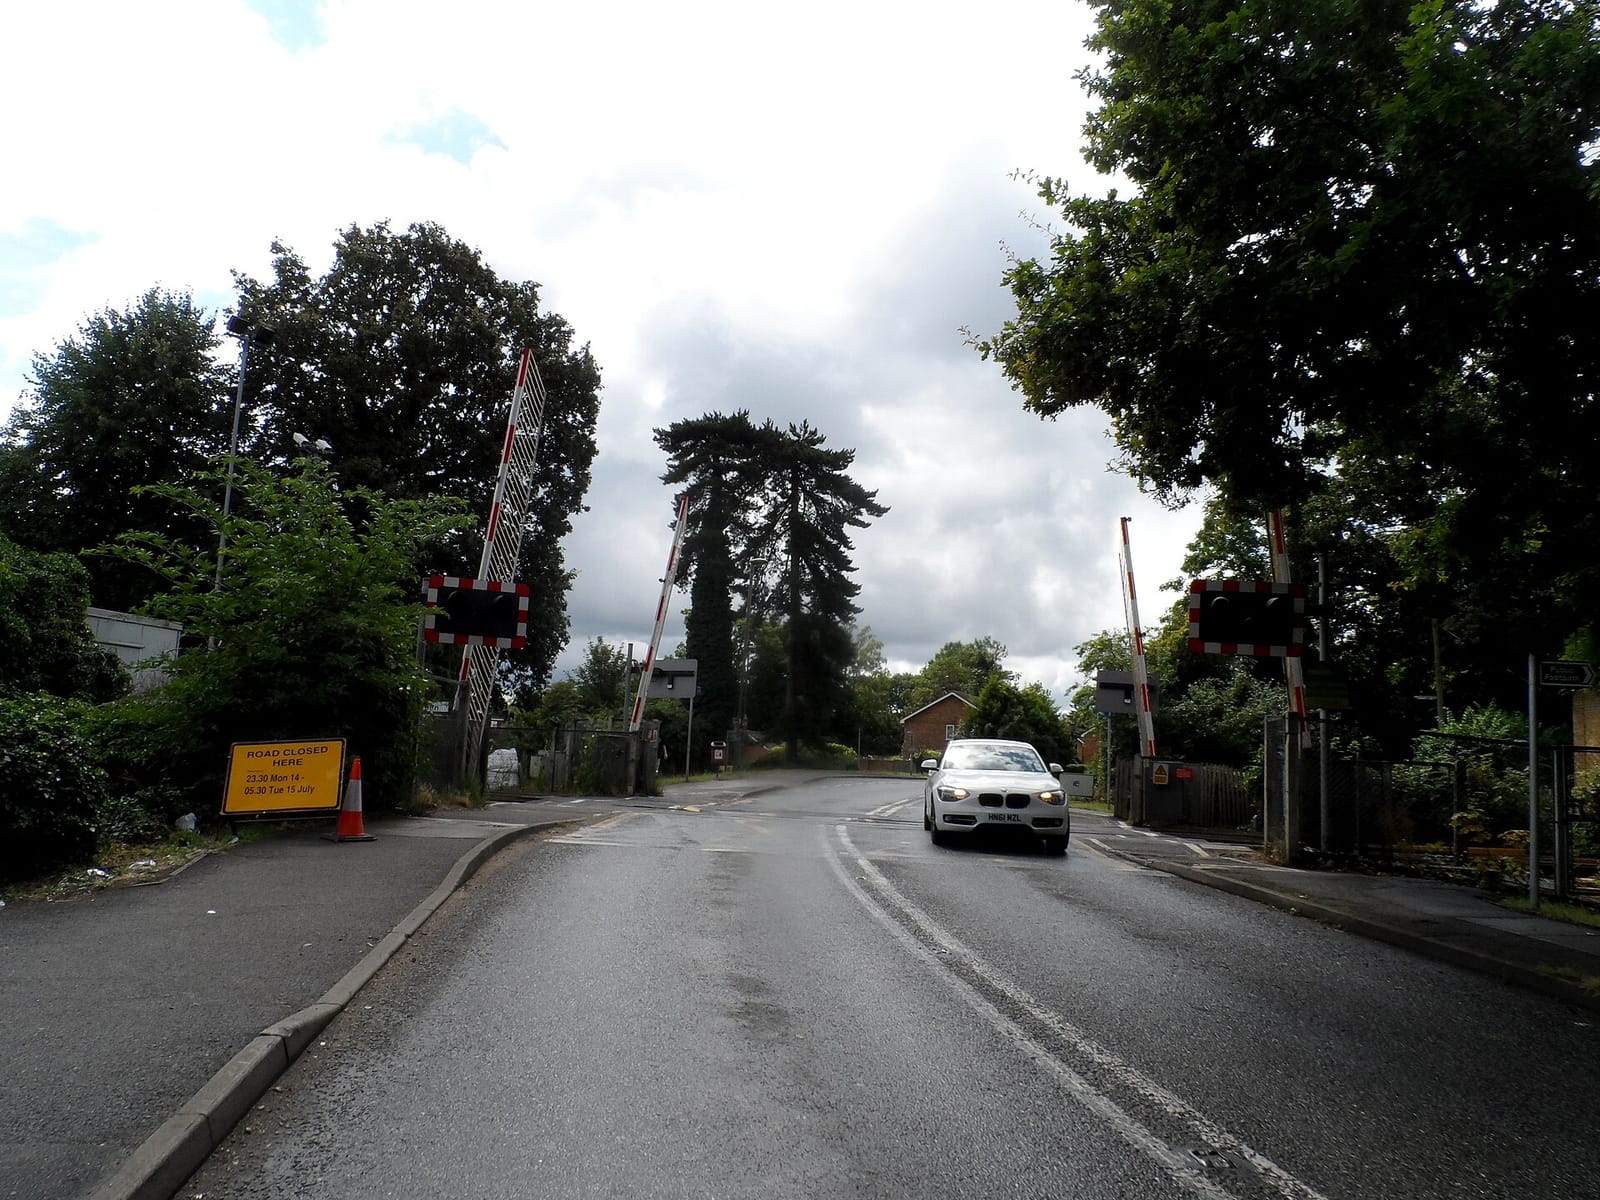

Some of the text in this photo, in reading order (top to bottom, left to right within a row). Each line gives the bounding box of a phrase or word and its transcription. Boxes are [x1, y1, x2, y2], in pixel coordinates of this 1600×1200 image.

[247, 745, 328, 759] ROAD CLOSED
[272, 758, 304, 767] HERE
[246, 774, 268, 783] 23.30
[270, 774, 288, 782] Mon
[290, 774, 300, 782] 14
[244, 785, 315, 795] 05.30 Tue 15 July
